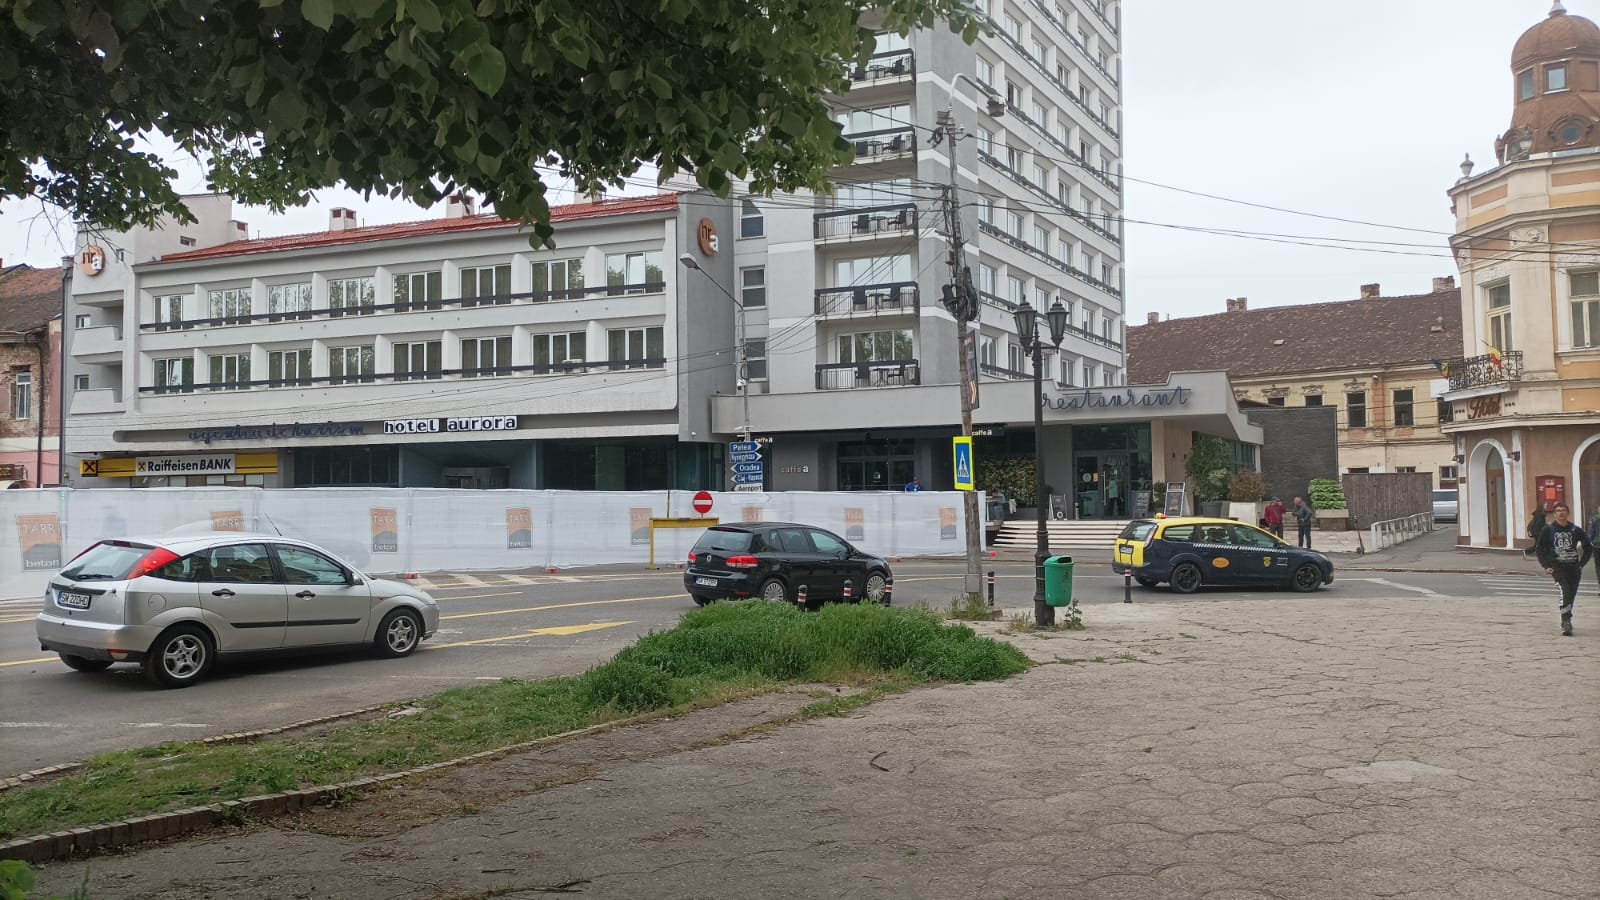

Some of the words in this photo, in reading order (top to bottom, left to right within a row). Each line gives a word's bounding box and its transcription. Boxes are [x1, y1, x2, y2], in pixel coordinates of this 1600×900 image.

[1041, 386, 1191, 410] restaurant
[1468, 395, 1501, 419] Hotel
[384, 419, 438, 433] hotel
[447, 417, 518, 431] aurora
[147, 460, 198, 472] Raiffeisen
[199, 459, 231, 470] BANK
[22, 523, 56, 534] TARR
[26, 559, 60, 568] beton
